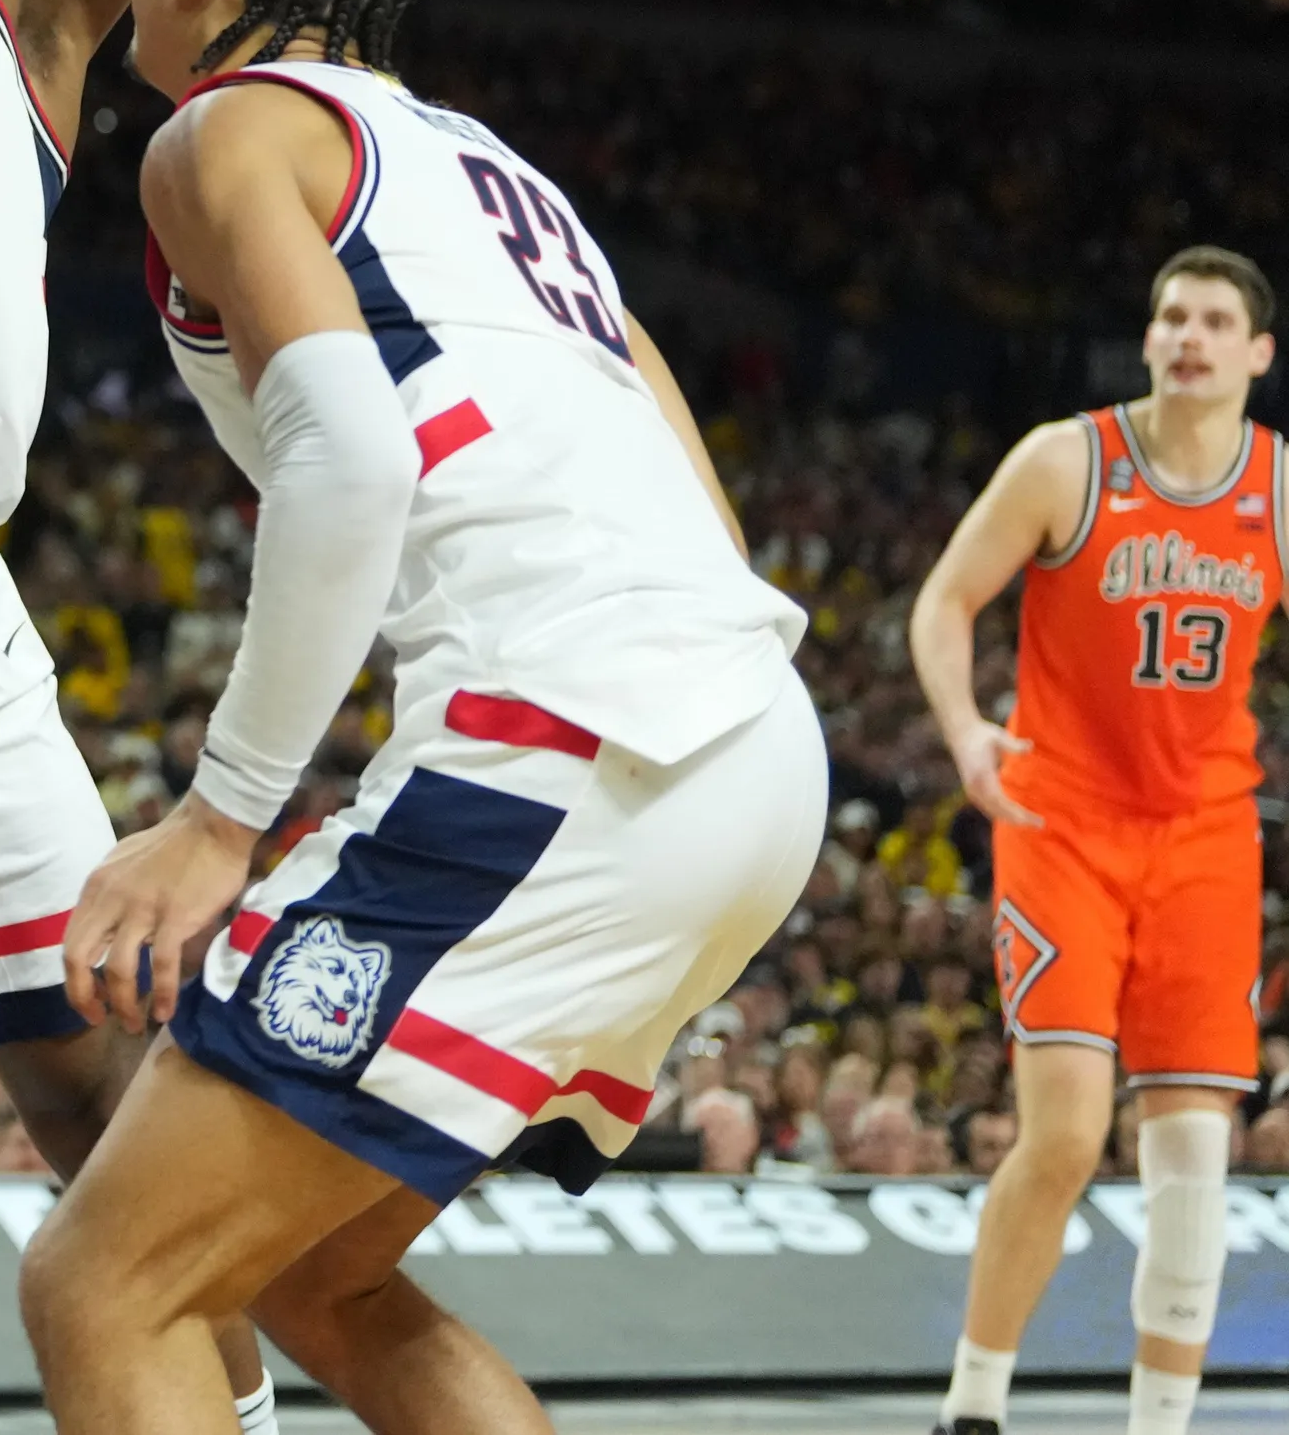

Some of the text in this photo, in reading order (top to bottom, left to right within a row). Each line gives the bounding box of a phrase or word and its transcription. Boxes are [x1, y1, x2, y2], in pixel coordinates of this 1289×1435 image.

[457, 152, 635, 367] 23
[1099, 529, 1266, 612] Illinois
[1130, 601, 1231, 692] 13
